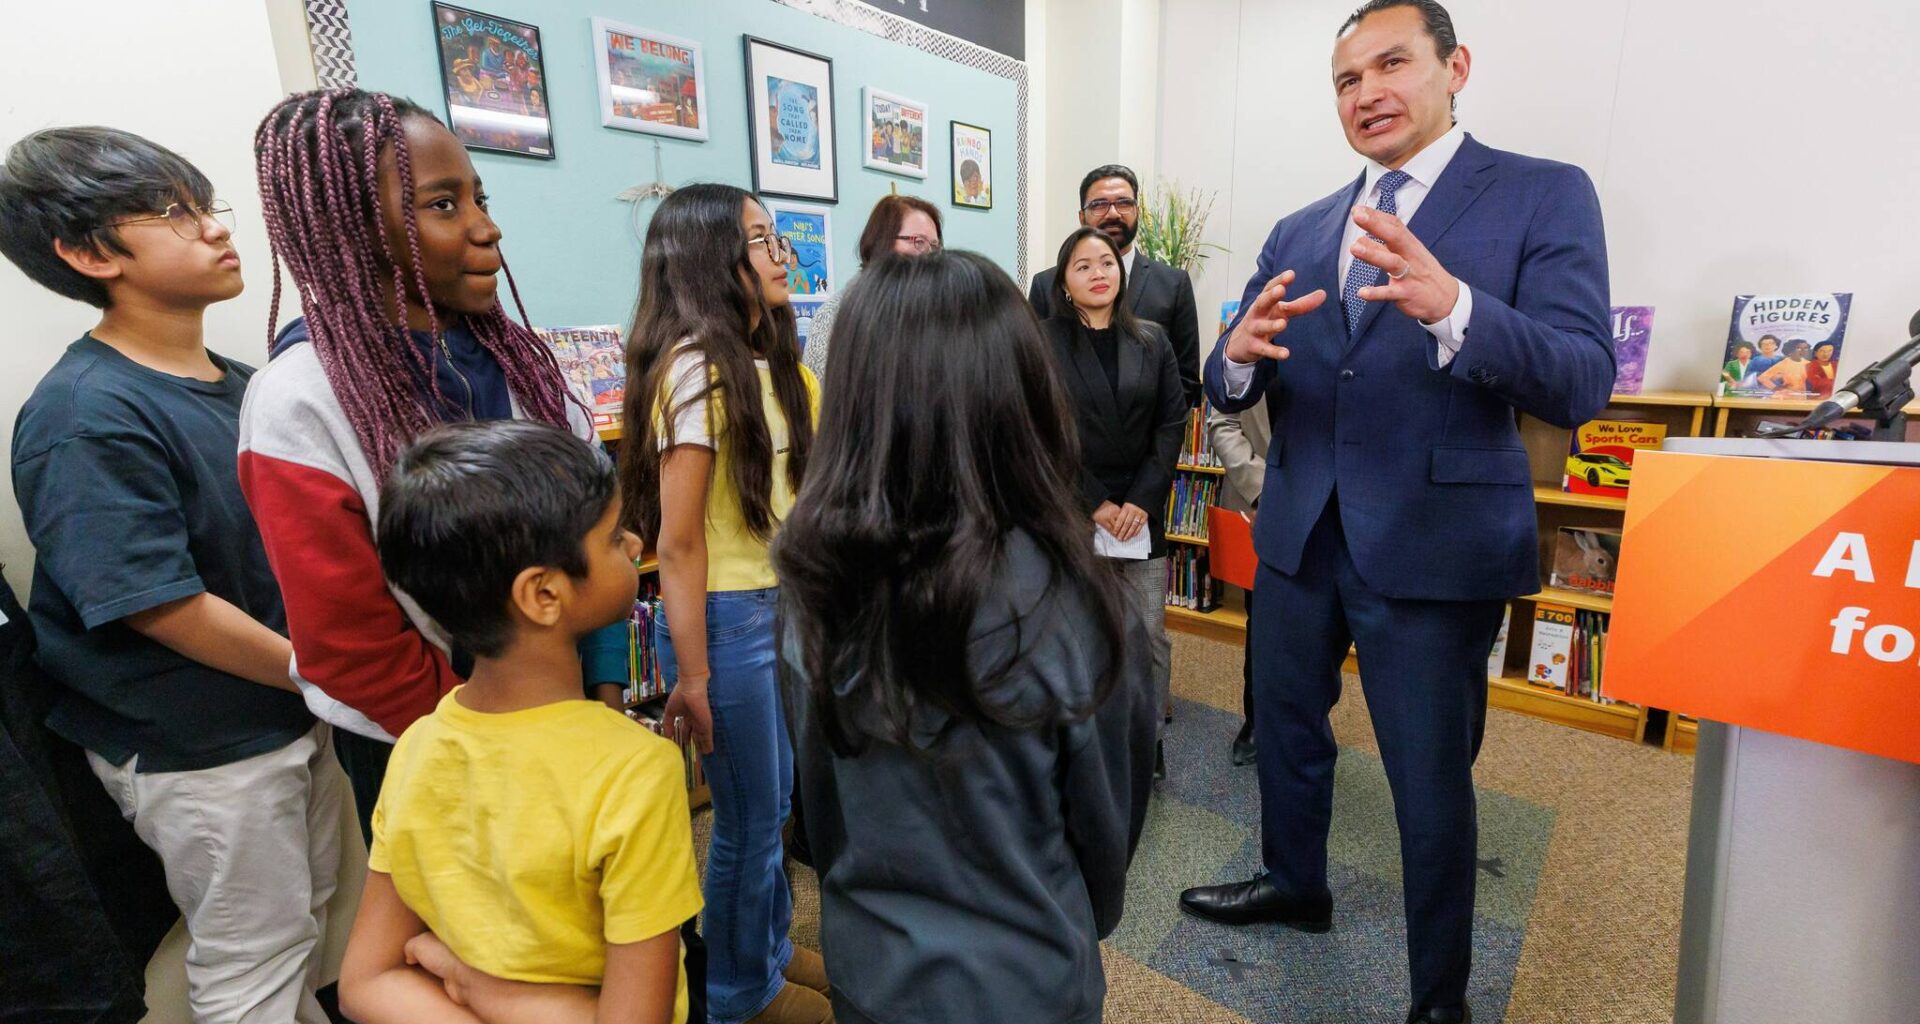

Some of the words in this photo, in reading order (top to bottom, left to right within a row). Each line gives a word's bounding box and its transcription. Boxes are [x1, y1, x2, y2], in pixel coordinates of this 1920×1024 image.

[442, 25, 463, 40] The
[611, 33, 635, 50] WE
[641, 40, 689, 64] BELONG
[782, 103, 805, 114] SONG
[780, 118, 808, 130] CALLED
[807, 233, 826, 244] SONG
[1753, 298, 1829, 313] HIDDEN
[1750, 311, 1831, 326] FIGURES
[1599, 424, 1615, 433] We
[1618, 425, 1643, 433] Love
[1585, 434, 1624, 445] Sports
[1628, 434, 1658, 444] Cars
[1811, 531, 1876, 583] A
[1536, 610, 1545, 619] E
[1548, 611, 1573, 623] 700
[1829, 606, 1920, 667] fo
